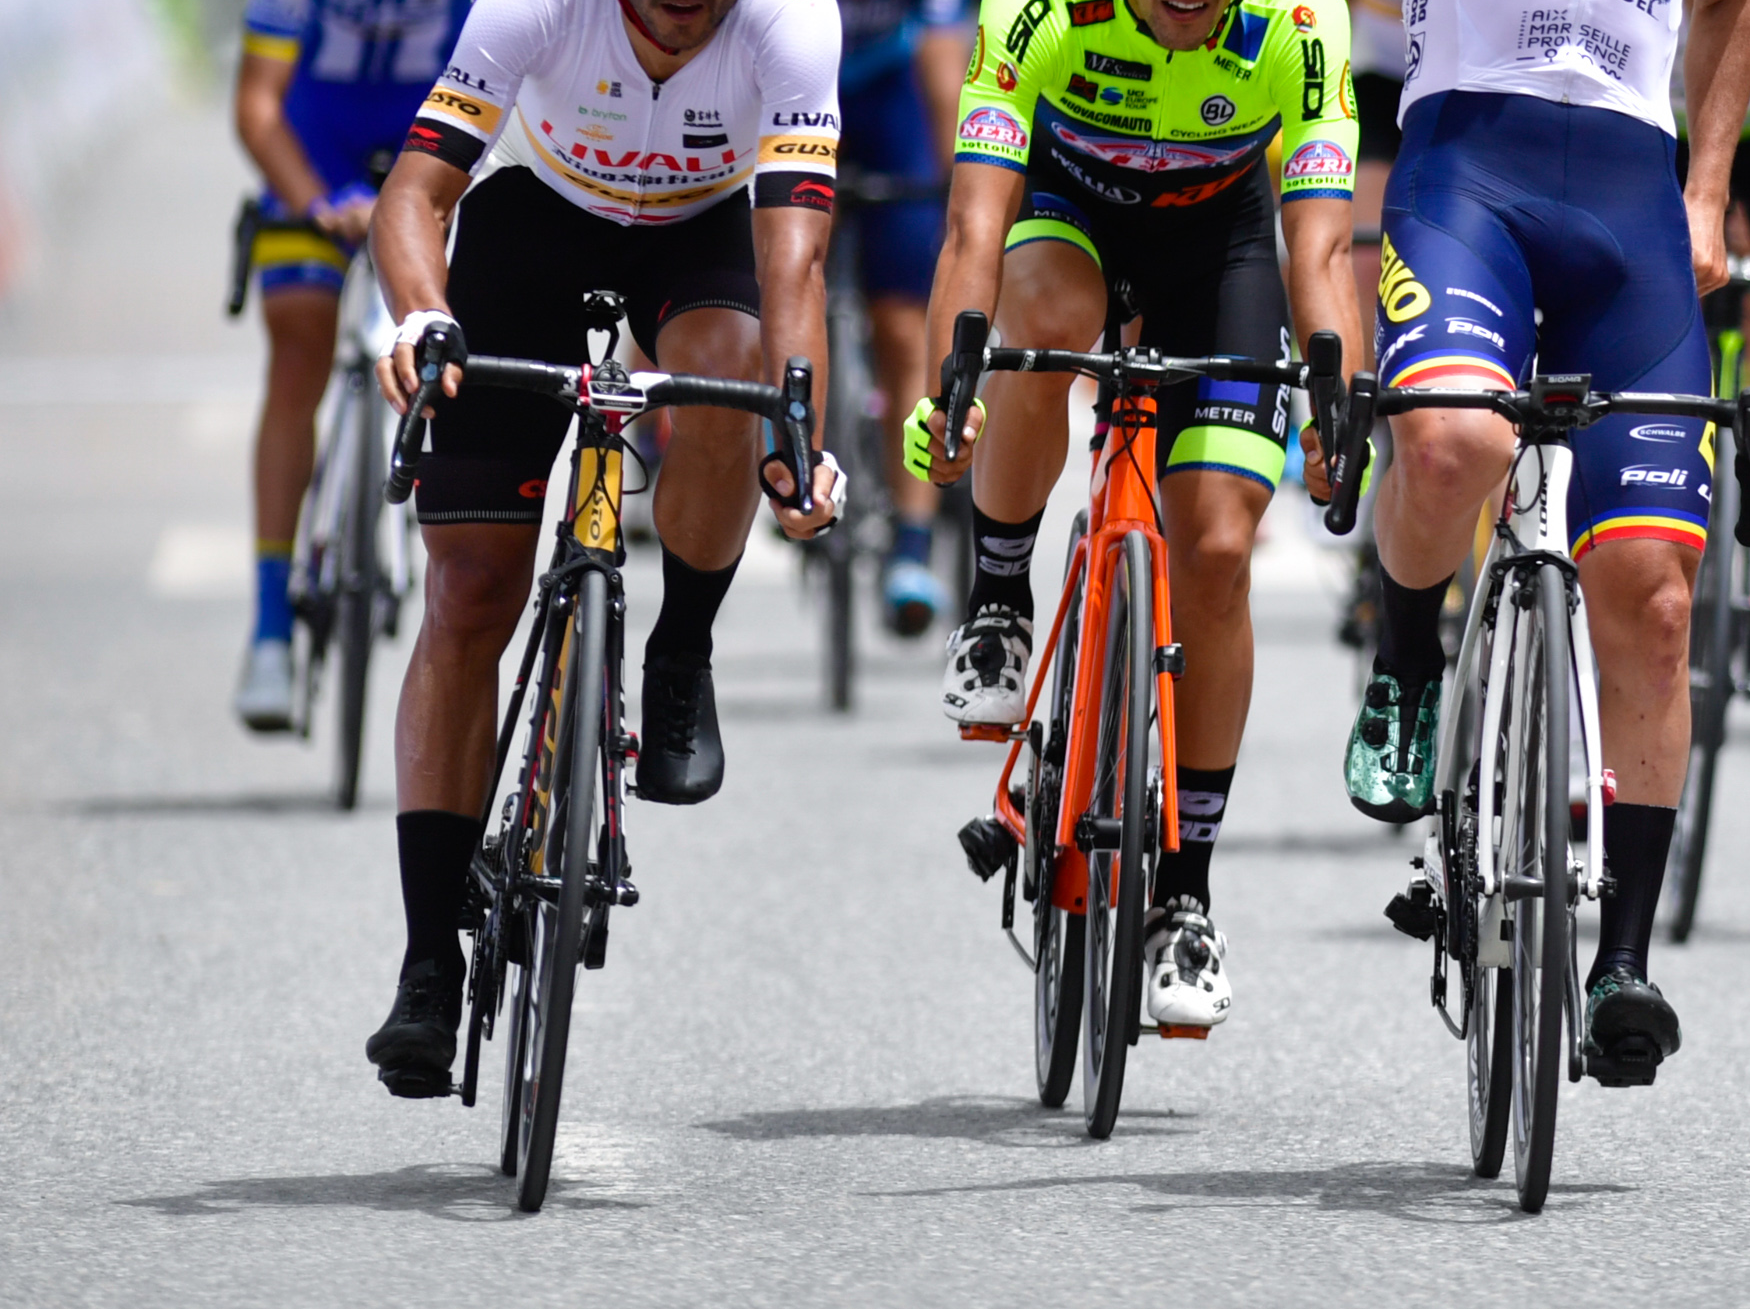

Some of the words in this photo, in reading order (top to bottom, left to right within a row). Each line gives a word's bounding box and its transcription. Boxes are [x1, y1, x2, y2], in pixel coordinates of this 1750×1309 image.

[1213, 54, 1253, 82] METER
[1125, 97, 1158, 106] EUROPE
[1125, 103, 1148, 111] TOUR
[1059, 96, 1152, 133] NUOVACOMAUTO
[960, 123, 1027, 148] NERI
[1170, 127, 1228, 139] CYCLING
[961, 140, 1023, 159] sottoli.it
[1285, 157, 1351, 177] NERI
[1286, 175, 1349, 189] sottoli.it
[1194, 406, 1256, 425] METER
[1639, 428, 1687, 438] SCHWALBE
[1620, 468, 1689, 487] poli
